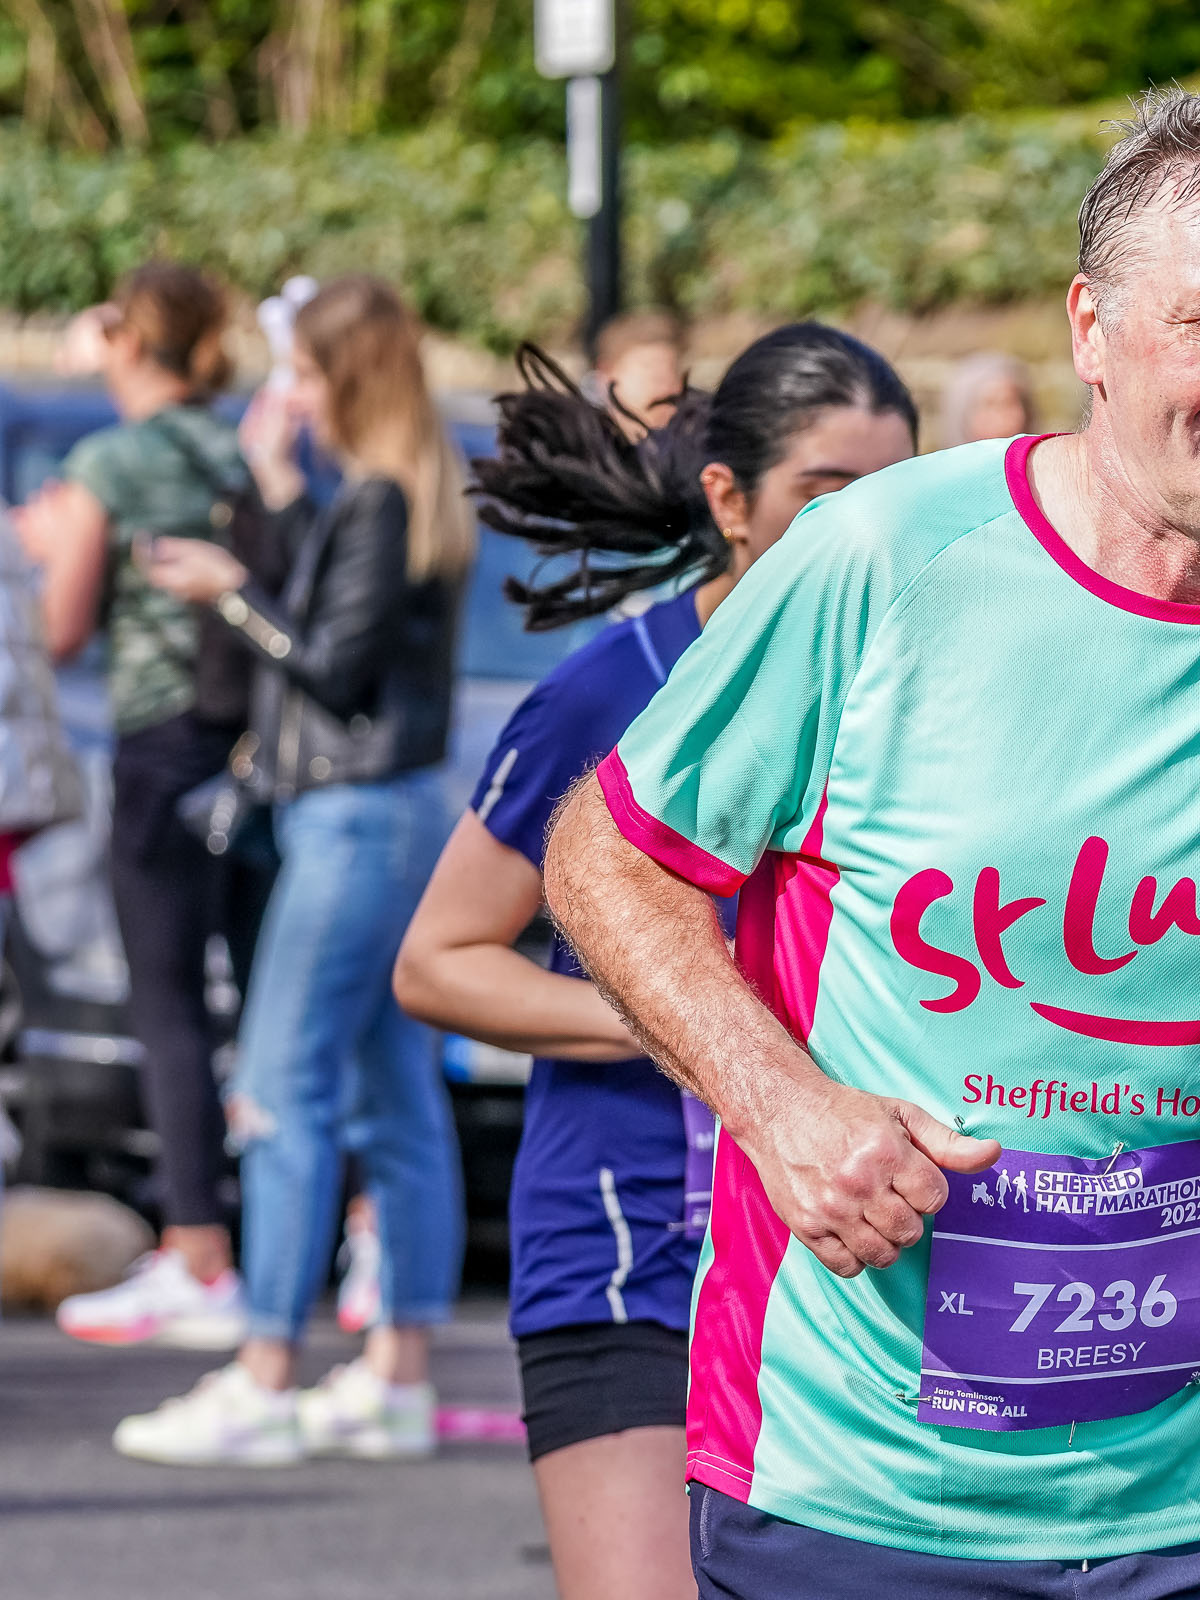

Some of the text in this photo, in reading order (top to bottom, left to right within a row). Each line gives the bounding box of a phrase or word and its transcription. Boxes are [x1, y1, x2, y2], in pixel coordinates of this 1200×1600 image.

[890, 867, 1047, 1014] St
[962, 1074, 1146, 1119] Sheffield's
[1037, 1171, 1141, 1192] SHEFFIELD
[1036, 1193, 1095, 1214] HALF
[938, 1291, 974, 1316] XL
[1009, 1274, 1178, 1333] 7236
[1037, 1341, 1147, 1370] BREESY
[932, 1396, 1028, 1417] RUN FOR ALL
[934, 1386, 1005, 1403] Jane Tomlinson's
